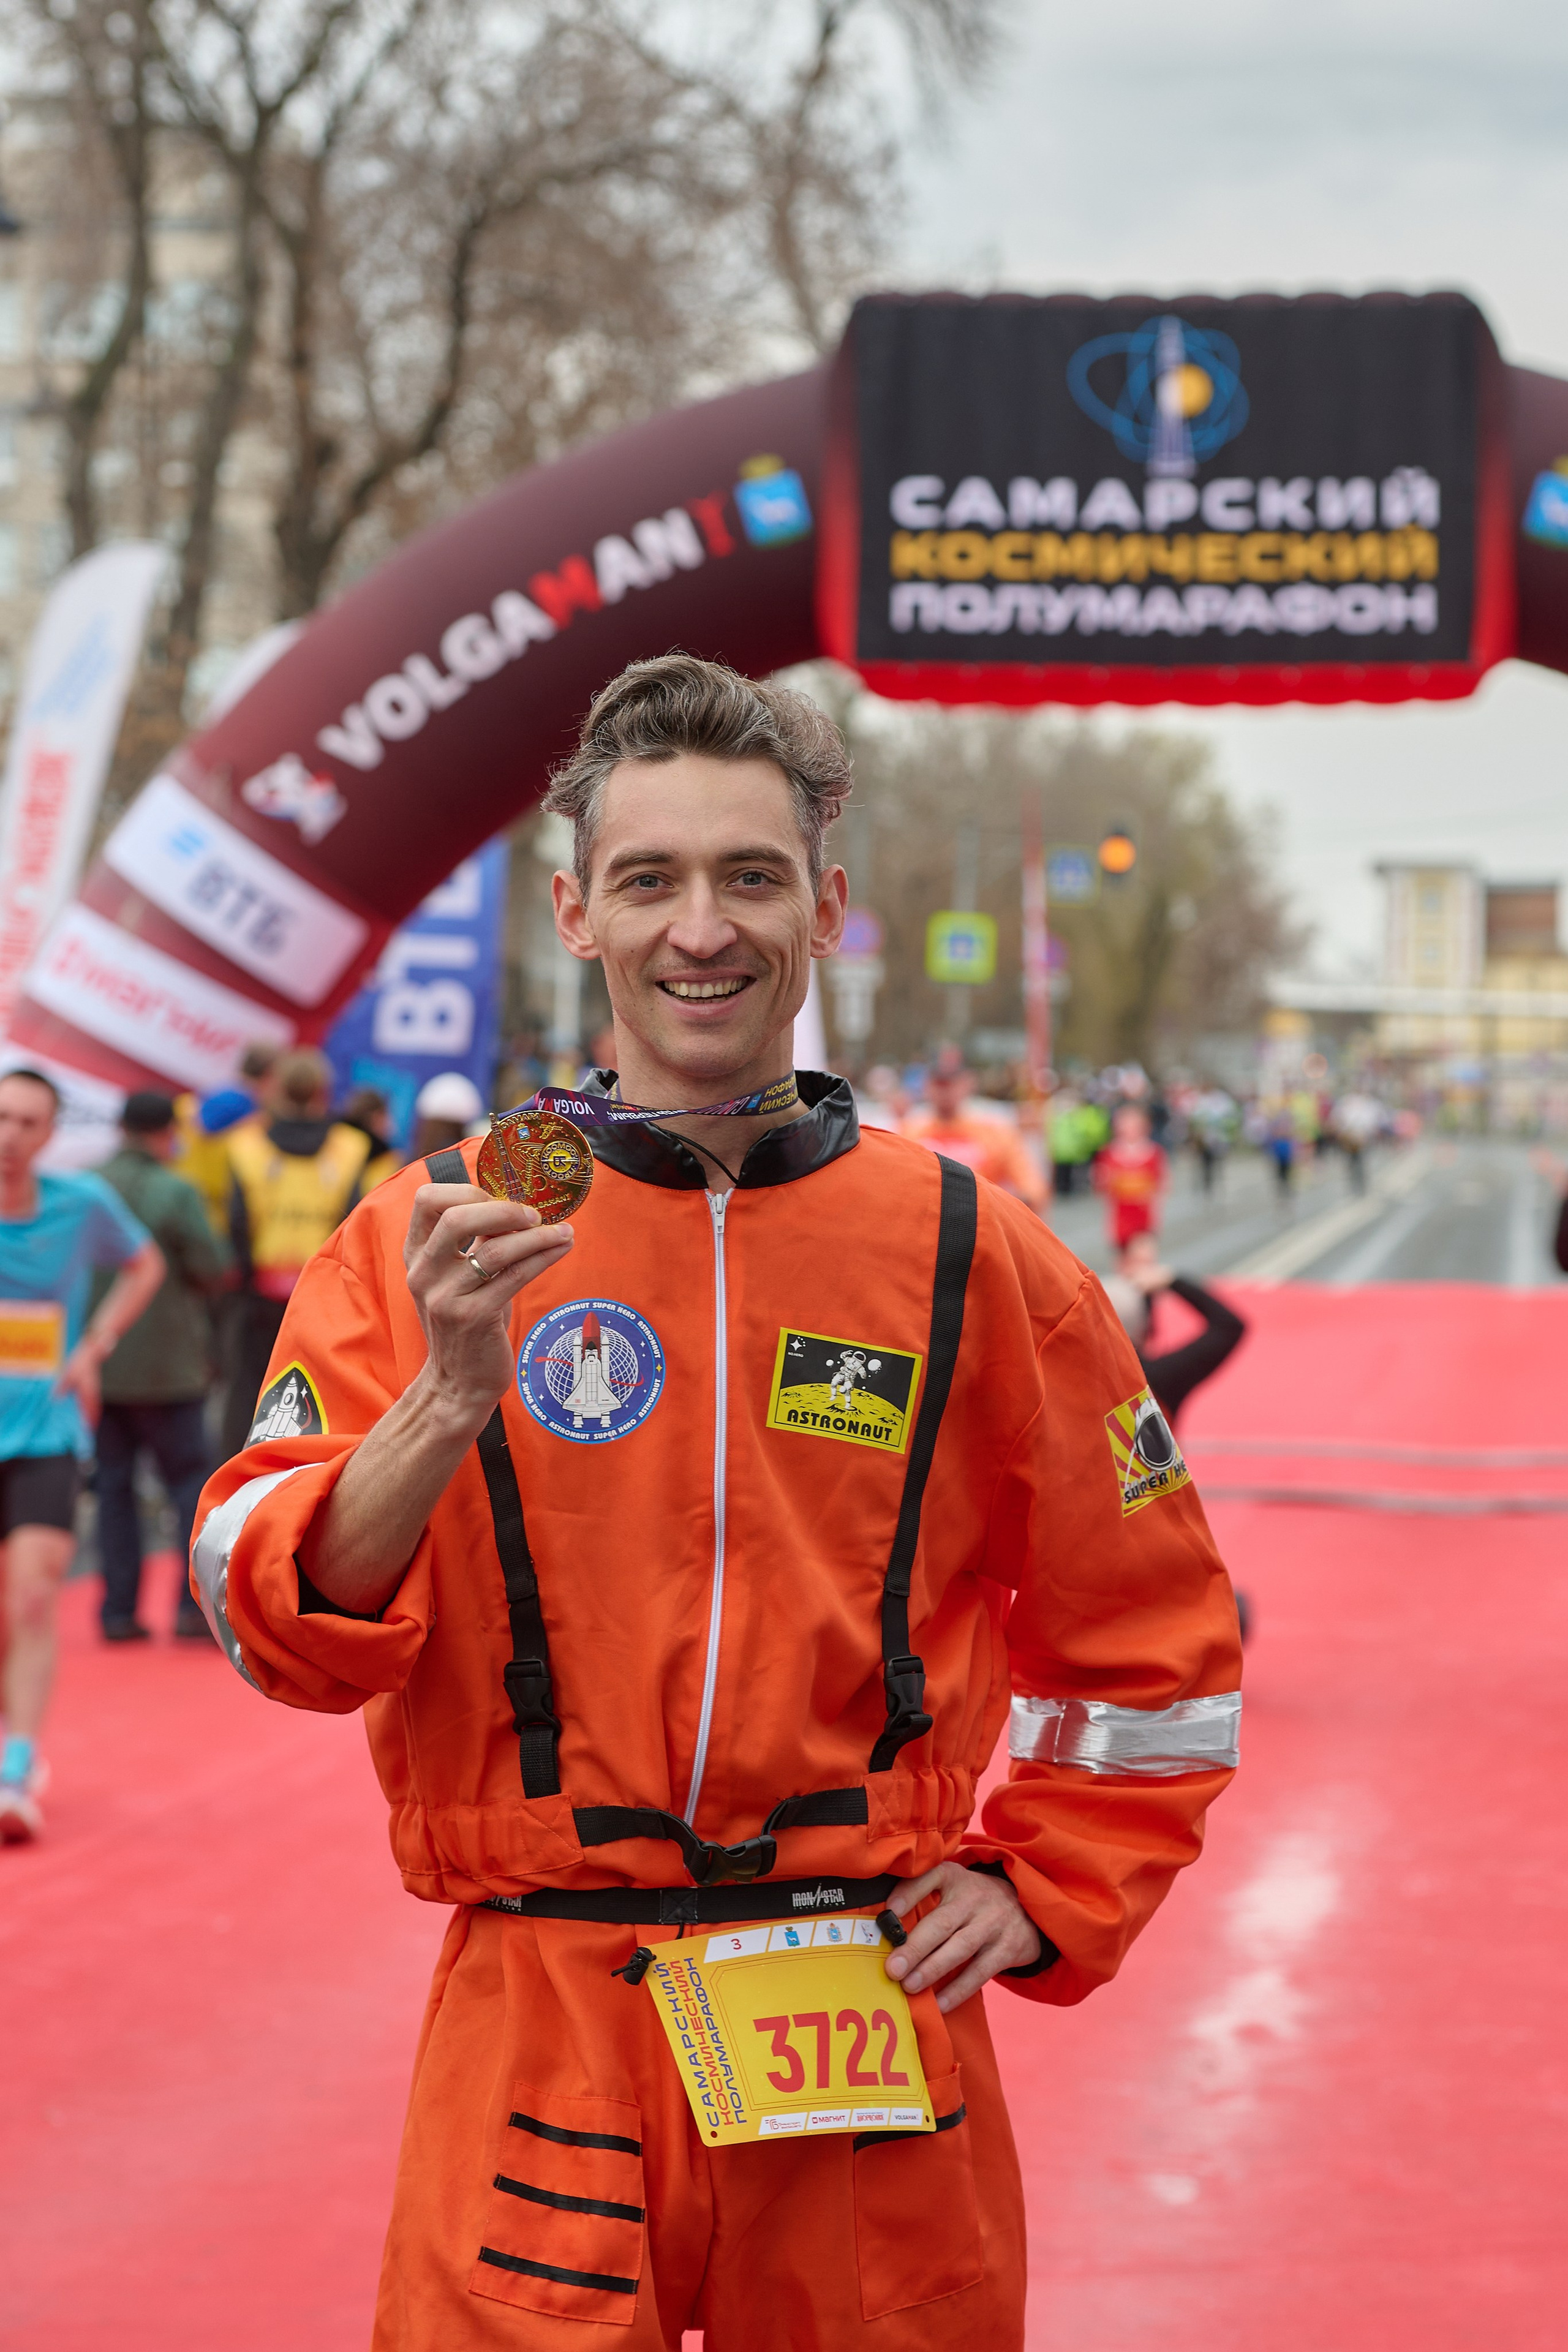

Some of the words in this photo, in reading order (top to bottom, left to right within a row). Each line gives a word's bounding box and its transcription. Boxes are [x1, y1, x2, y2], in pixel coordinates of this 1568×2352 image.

[889, 468, 1441, 530] САМАРСКИЙ
[889, 526, 1439, 583] КОСМИЧЕСКИЙ
[889, 583, 1439, 636] ПОЛУМАРАФОН
[522, 1338, 533, 1363] SUPER
[530, 1322, 546, 1341] HERO
[548, 1302, 590, 1322] ASTRONAUT
[592, 1302, 616, 1311] SUPER
[617, 1306, 636, 1320] HERO
[637, 1321, 662, 1359] ASTRONAUT
[522, 1382, 532, 1405] SUPER
[530, 1404, 547, 1421] HERO
[548, 1421, 590, 1439] ASTRONAUT
[593, 1430, 617, 1439] SUPER
[617, 1419, 637, 1433] HERO
[638, 1379, 662, 1417] ASTRONAUT
[787, 1409, 892, 1441] ASTRONAUT
[1124, 1472, 1169, 1504] SUPER
[731, 1939, 742, 1950] 3
[653, 1962, 720, 2127] САМАРСКИЙ
[668, 1960, 734, 2126] КОСМИЧЕСКИЙ
[684, 1957, 747, 2124] ПОЛУМАРАФОН
[753, 2008, 910, 2094] 3722
